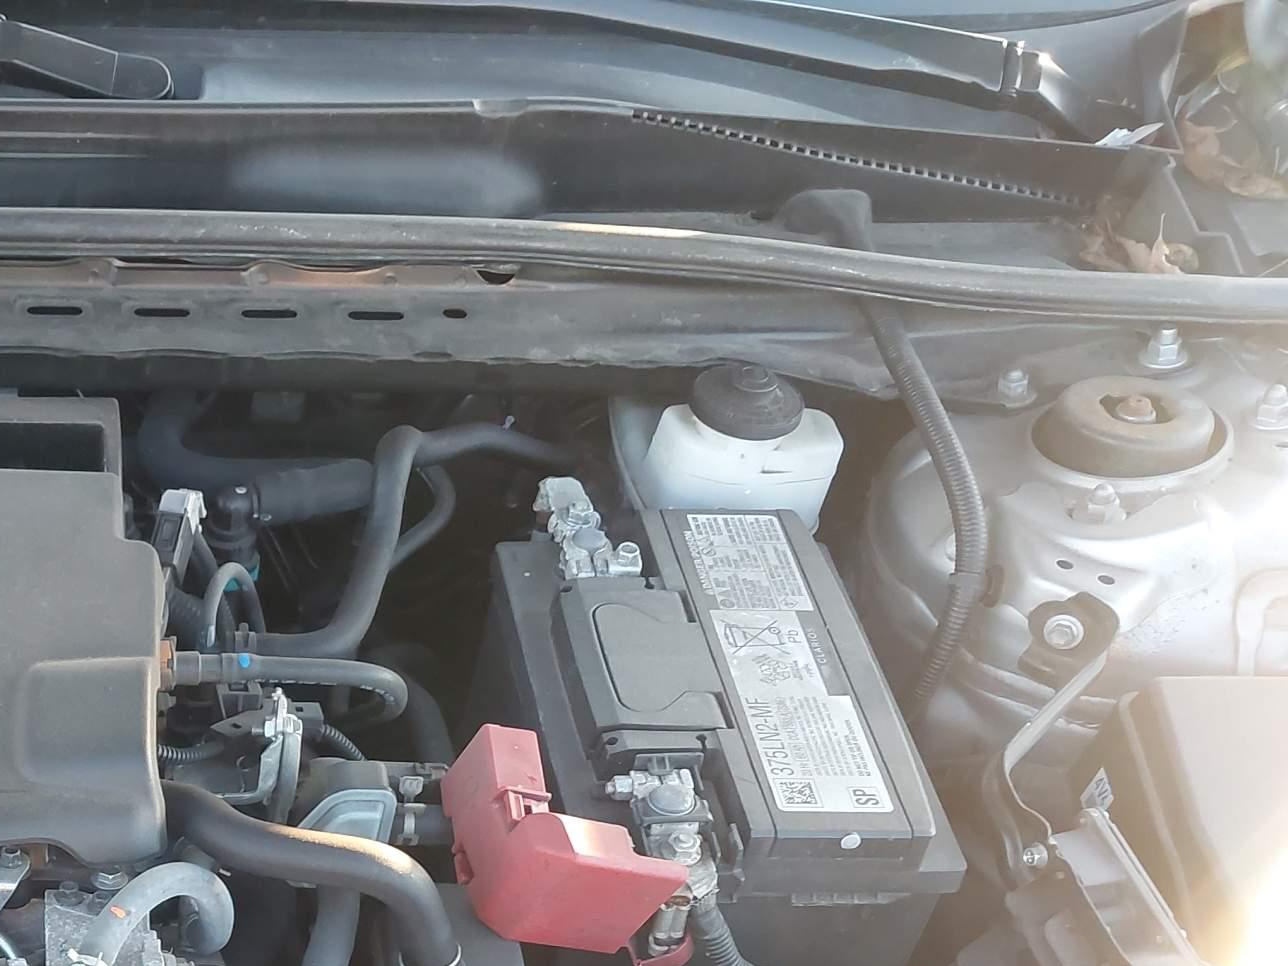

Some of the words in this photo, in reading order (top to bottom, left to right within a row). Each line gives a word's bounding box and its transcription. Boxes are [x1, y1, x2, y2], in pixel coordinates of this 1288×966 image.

[682, 530, 701, 560] POISON
[693, 559, 713, 589] DANGER
[784, 629, 802, 644] Pb
[744, 697, 795, 777] 375LN2-MF
[852, 788, 880, 806] SP
